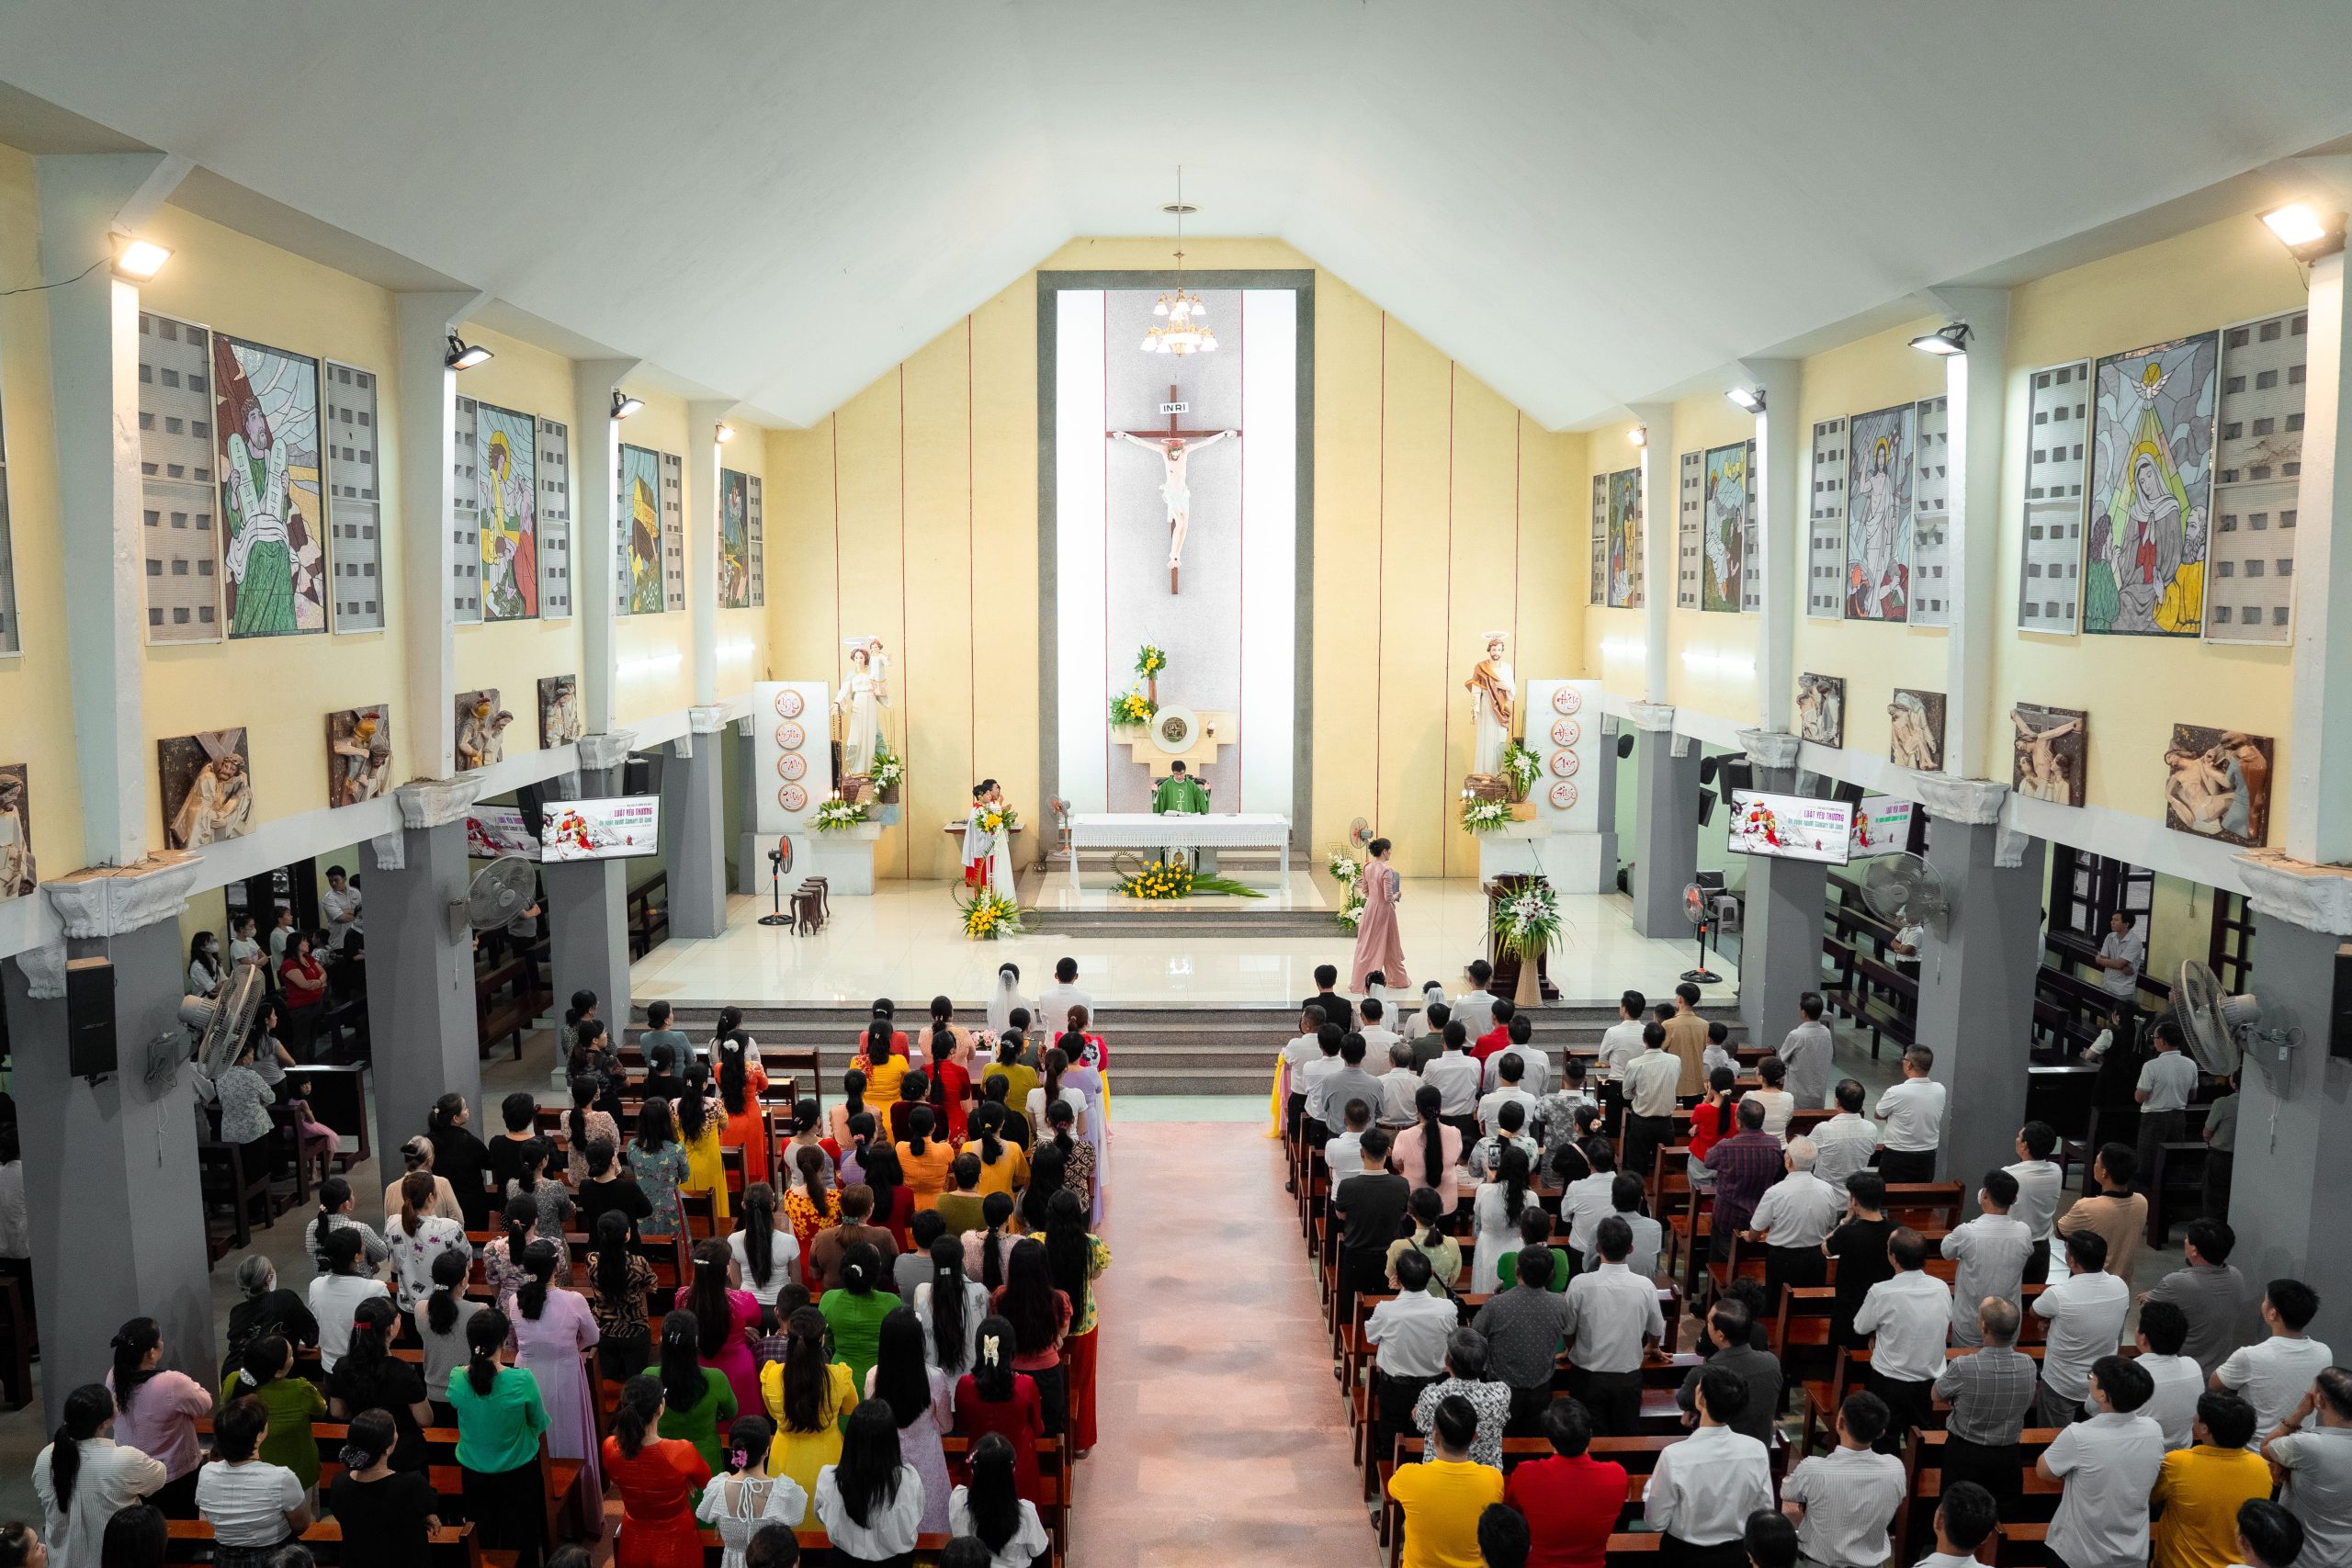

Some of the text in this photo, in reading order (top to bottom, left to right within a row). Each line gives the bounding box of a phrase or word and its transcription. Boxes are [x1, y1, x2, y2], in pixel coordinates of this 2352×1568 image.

[1163, 403, 1186, 412] INRI
[236, 456, 244, 468] II
[240, 469, 248, 482] III
